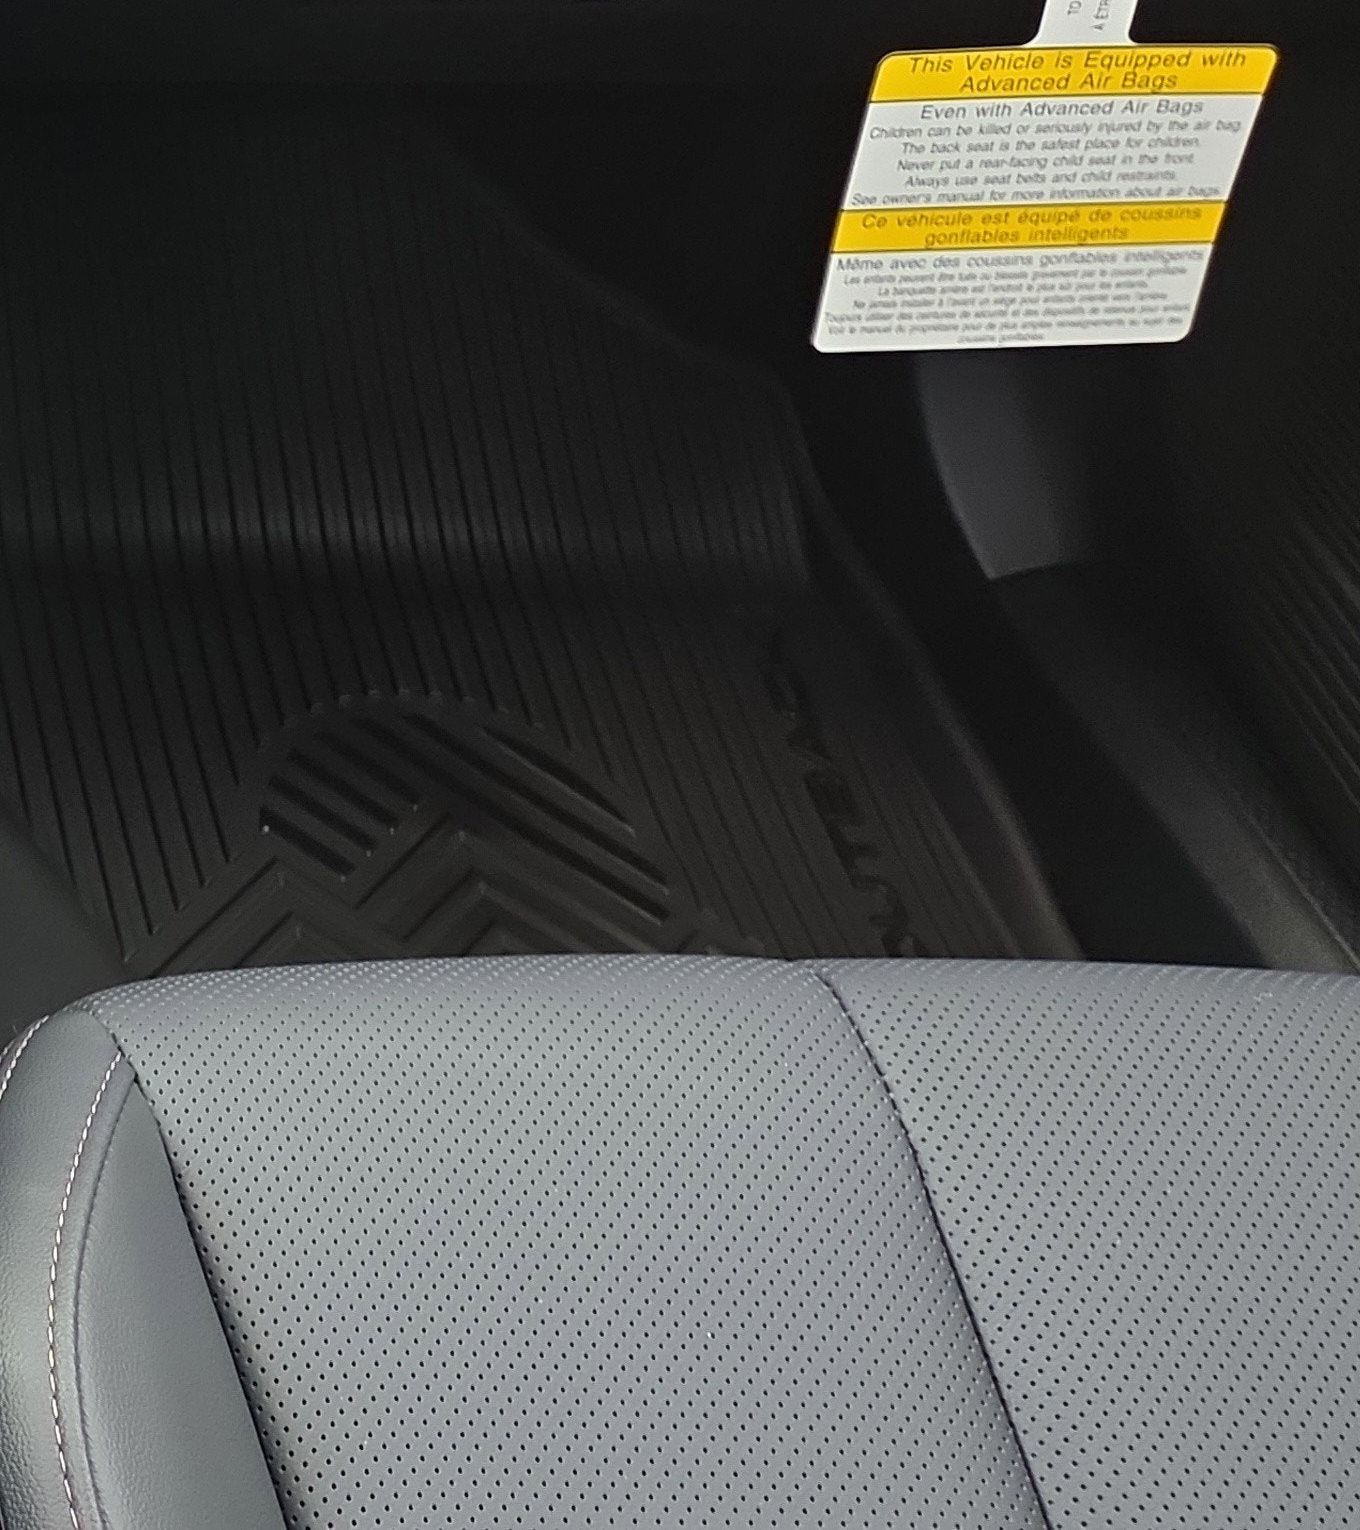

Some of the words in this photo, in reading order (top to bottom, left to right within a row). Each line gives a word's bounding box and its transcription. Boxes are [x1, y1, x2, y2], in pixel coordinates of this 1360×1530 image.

[909, 55, 954, 73] This
[966, 52, 1044, 71] Vehicle
[1055, 51, 1074, 69] is
[1084, 50, 1192, 71] Equipped
[1202, 50, 1247, 68] with
[959, 73, 1071, 93] Advanced
[1080, 72, 1113, 90] Air
[1121, 70, 1178, 91] Bags
[920, 104, 967, 120] Even
[976, 102, 1012, 118] with
[1022, 100, 1115, 118] Advanced
[1121, 99, 1150, 114] Air
[1156, 98, 1205, 117] Bags
[862, 213, 888, 229] Ce
[981, 210, 1010, 225] est
[1088, 208, 1113, 222] de
